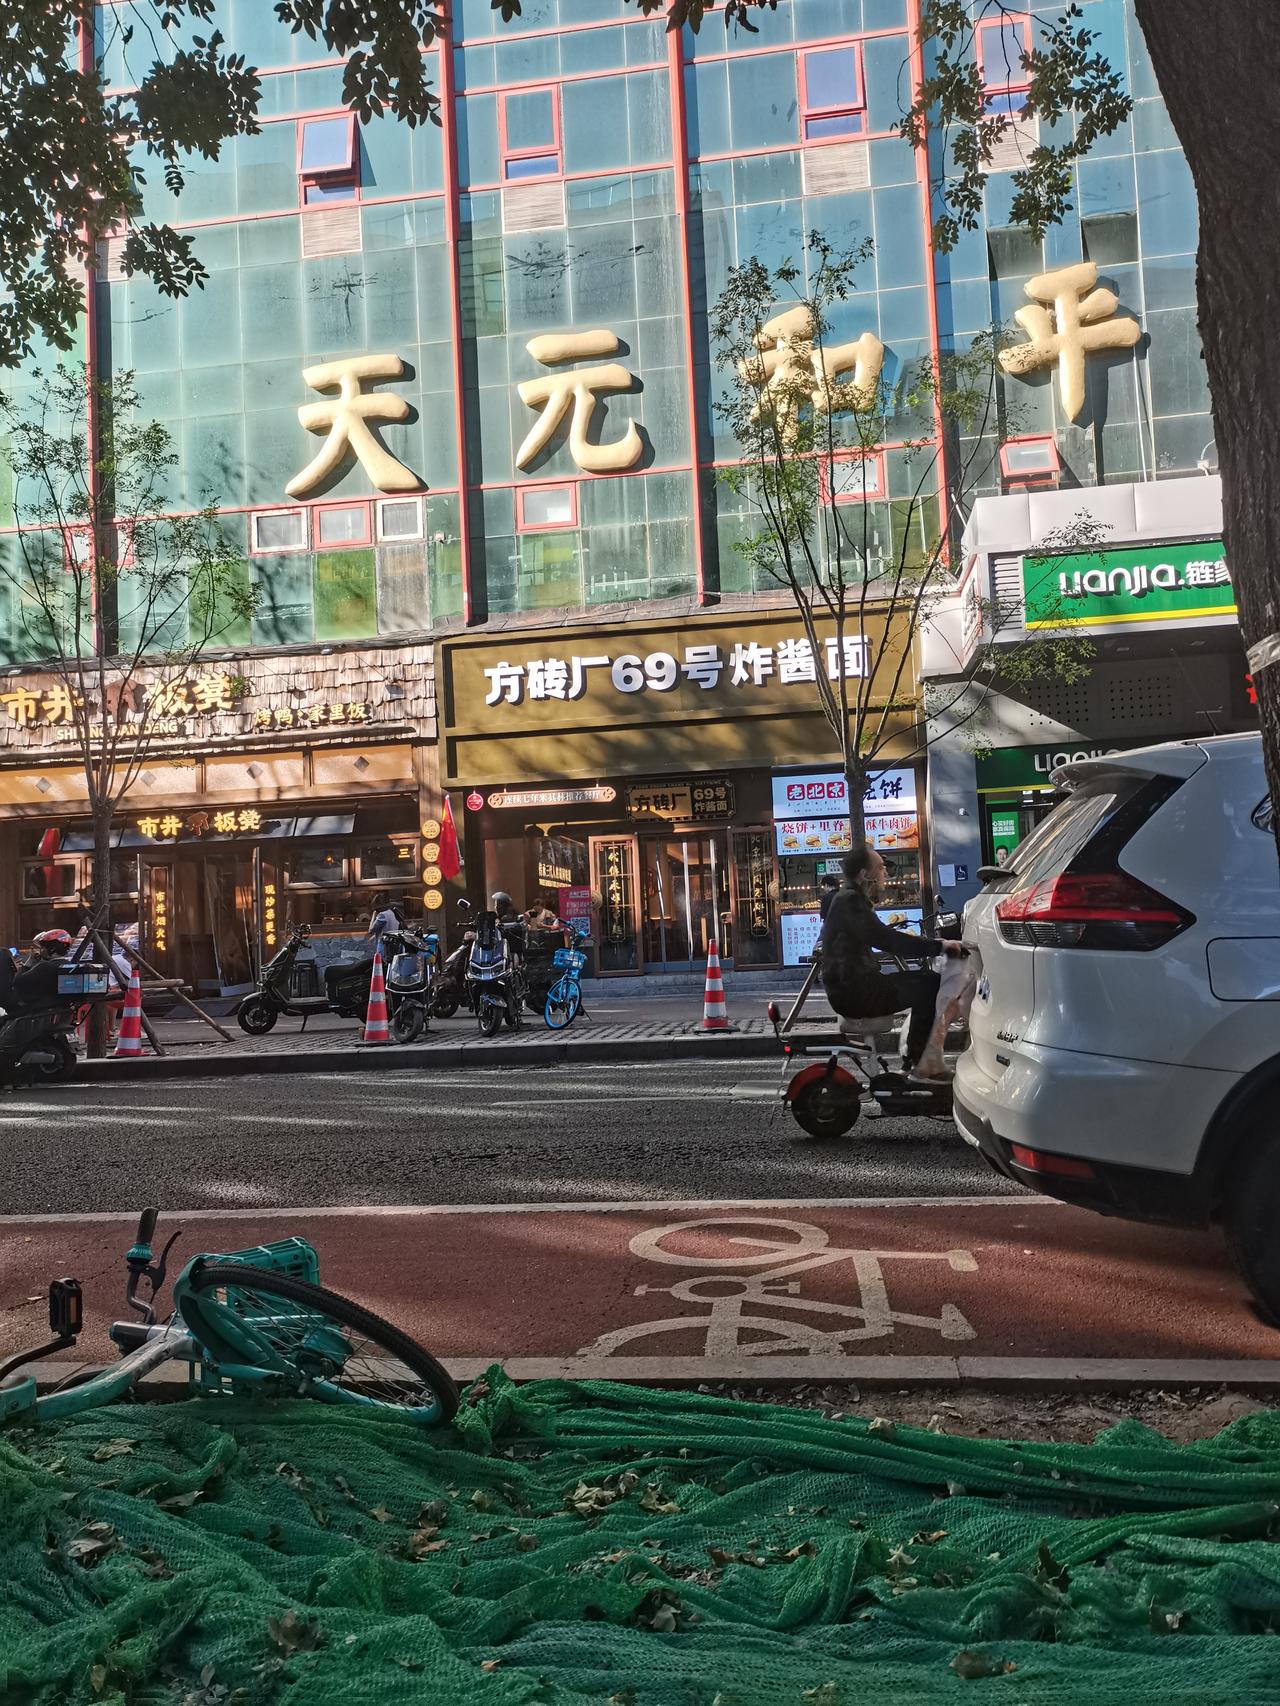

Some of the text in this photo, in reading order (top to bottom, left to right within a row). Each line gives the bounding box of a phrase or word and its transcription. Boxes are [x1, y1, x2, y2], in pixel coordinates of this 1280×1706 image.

[285, 262, 1141, 496] 天元和平
[484, 634, 869, 705] 方砖厂69号炸酱面
[694, 787, 726, 800] 69号
[787, 783, 844, 799] 老北京
[694, 800, 728, 813] 炸酱面
[137, 809, 261, 838] 市井 板凳
[155, 891, 167, 951] 市井烟火气
